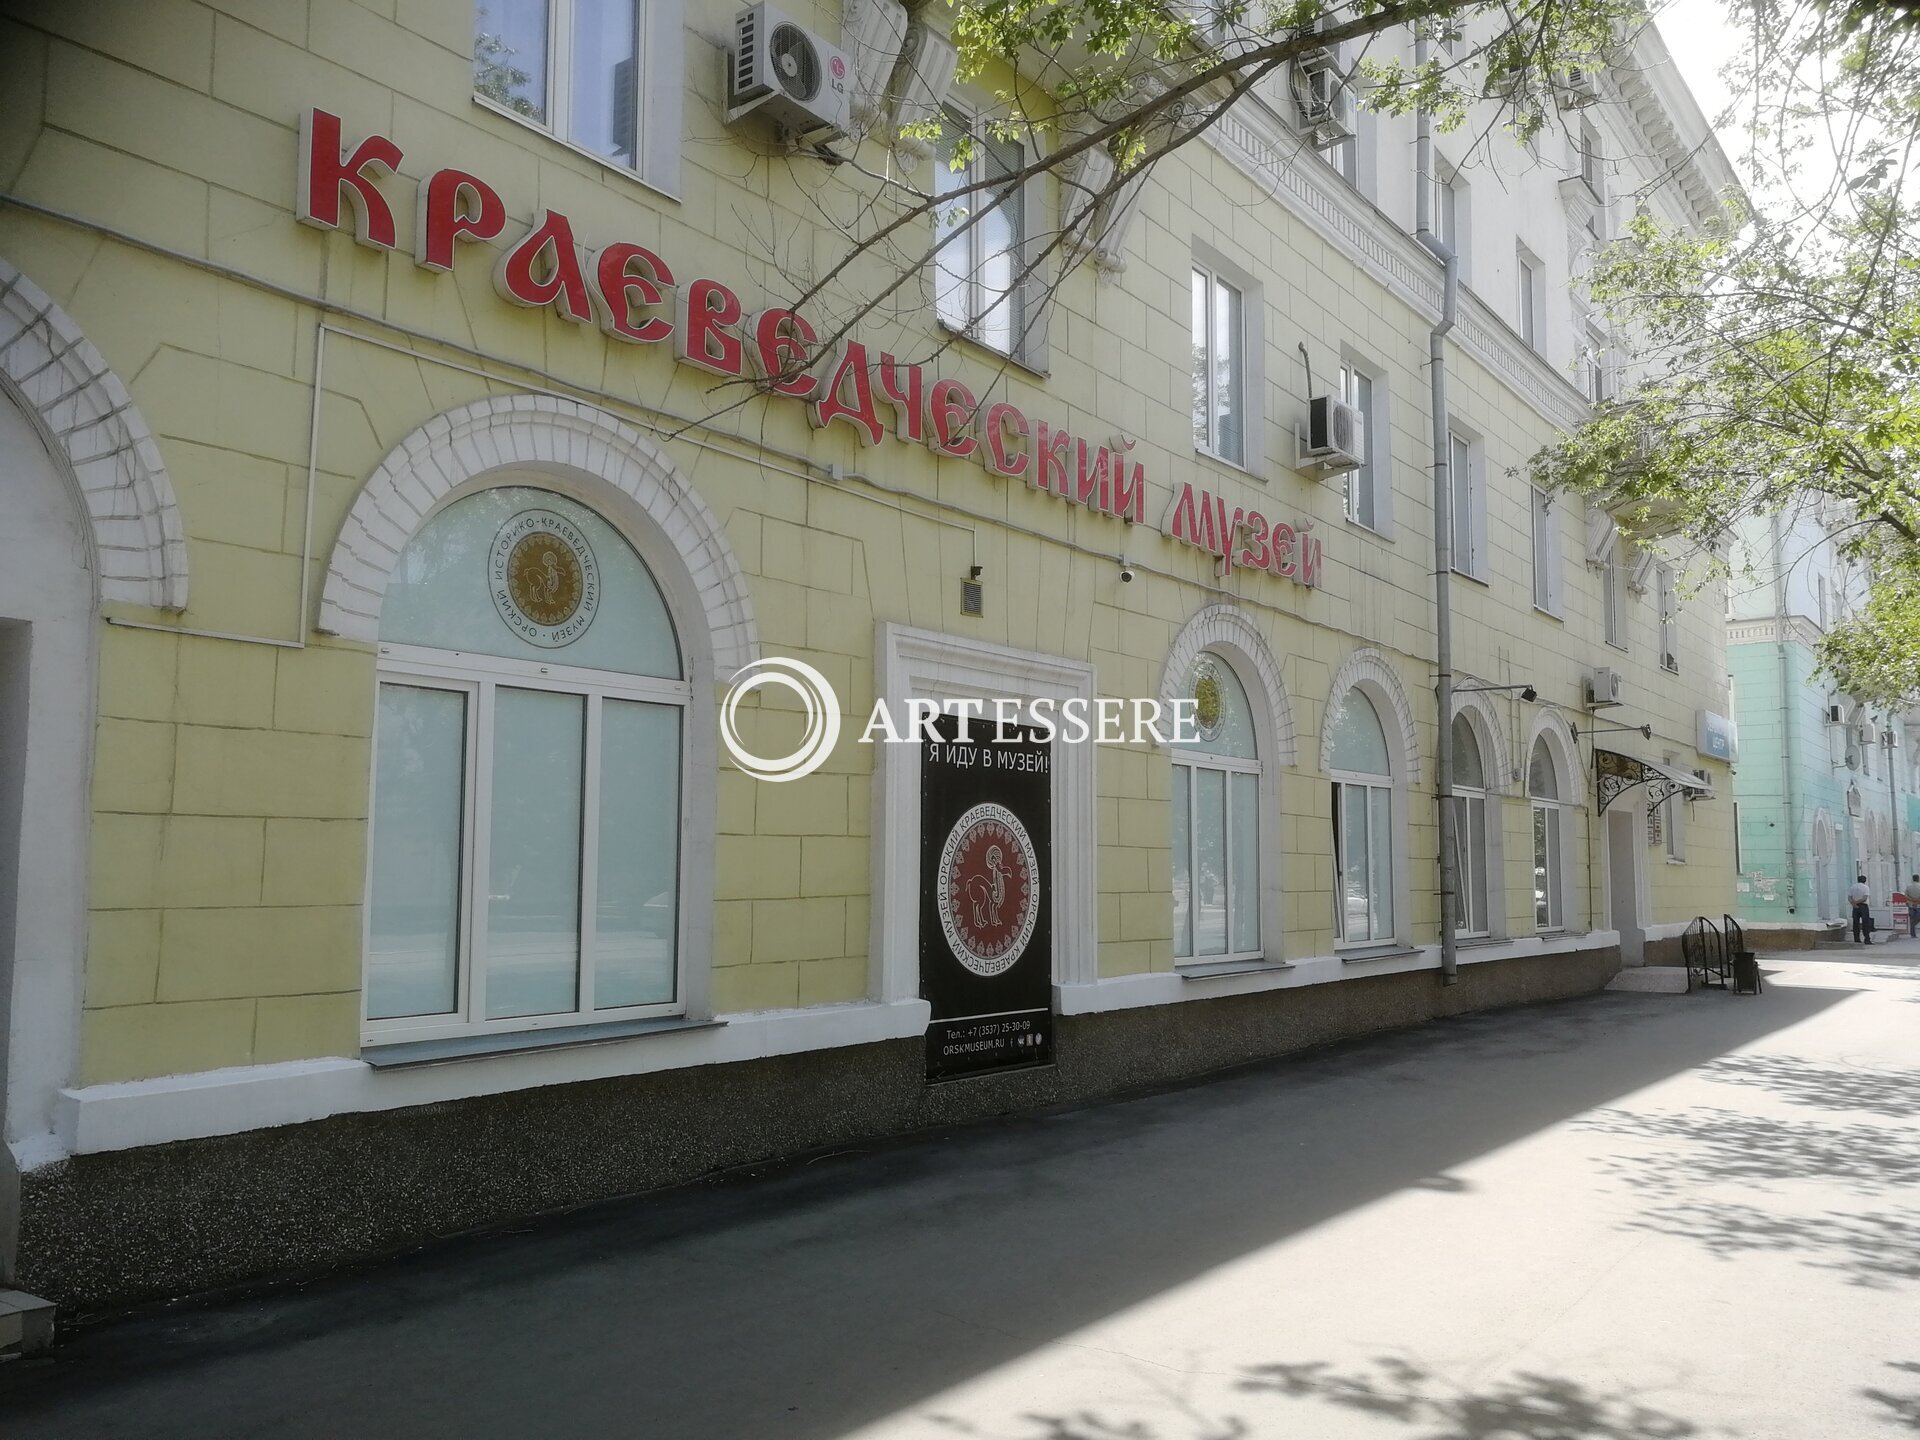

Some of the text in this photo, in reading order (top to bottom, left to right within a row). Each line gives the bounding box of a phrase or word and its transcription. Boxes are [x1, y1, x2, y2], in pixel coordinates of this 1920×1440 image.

[831, 78, 844, 95] LG
[298, 107, 1322, 589] КРАЕВЕДЧЕСКИЙ МУЗЕЙ
[497, 589, 538, 637] ОРСКИЙ
[551, 615, 585, 643] МУЗЕЙ
[929, 743, 1049, 774] Я ИДУ В МУЗЕЙ!
[939, 805, 1040, 886] ОРСКИЙ КРАЕВЕДЧЕСКИЙ МУЗЕЙ
[938, 891, 1038, 974] ОРСКИЙ КРАЕВЕДЧЕСКИЙ МУЗЕЙ
[943, 1038, 1005, 1056] ORSKMUSEUM.RU
[946, 1020, 1031, 1040] Тел.: +7 (3537) 25-30-09
